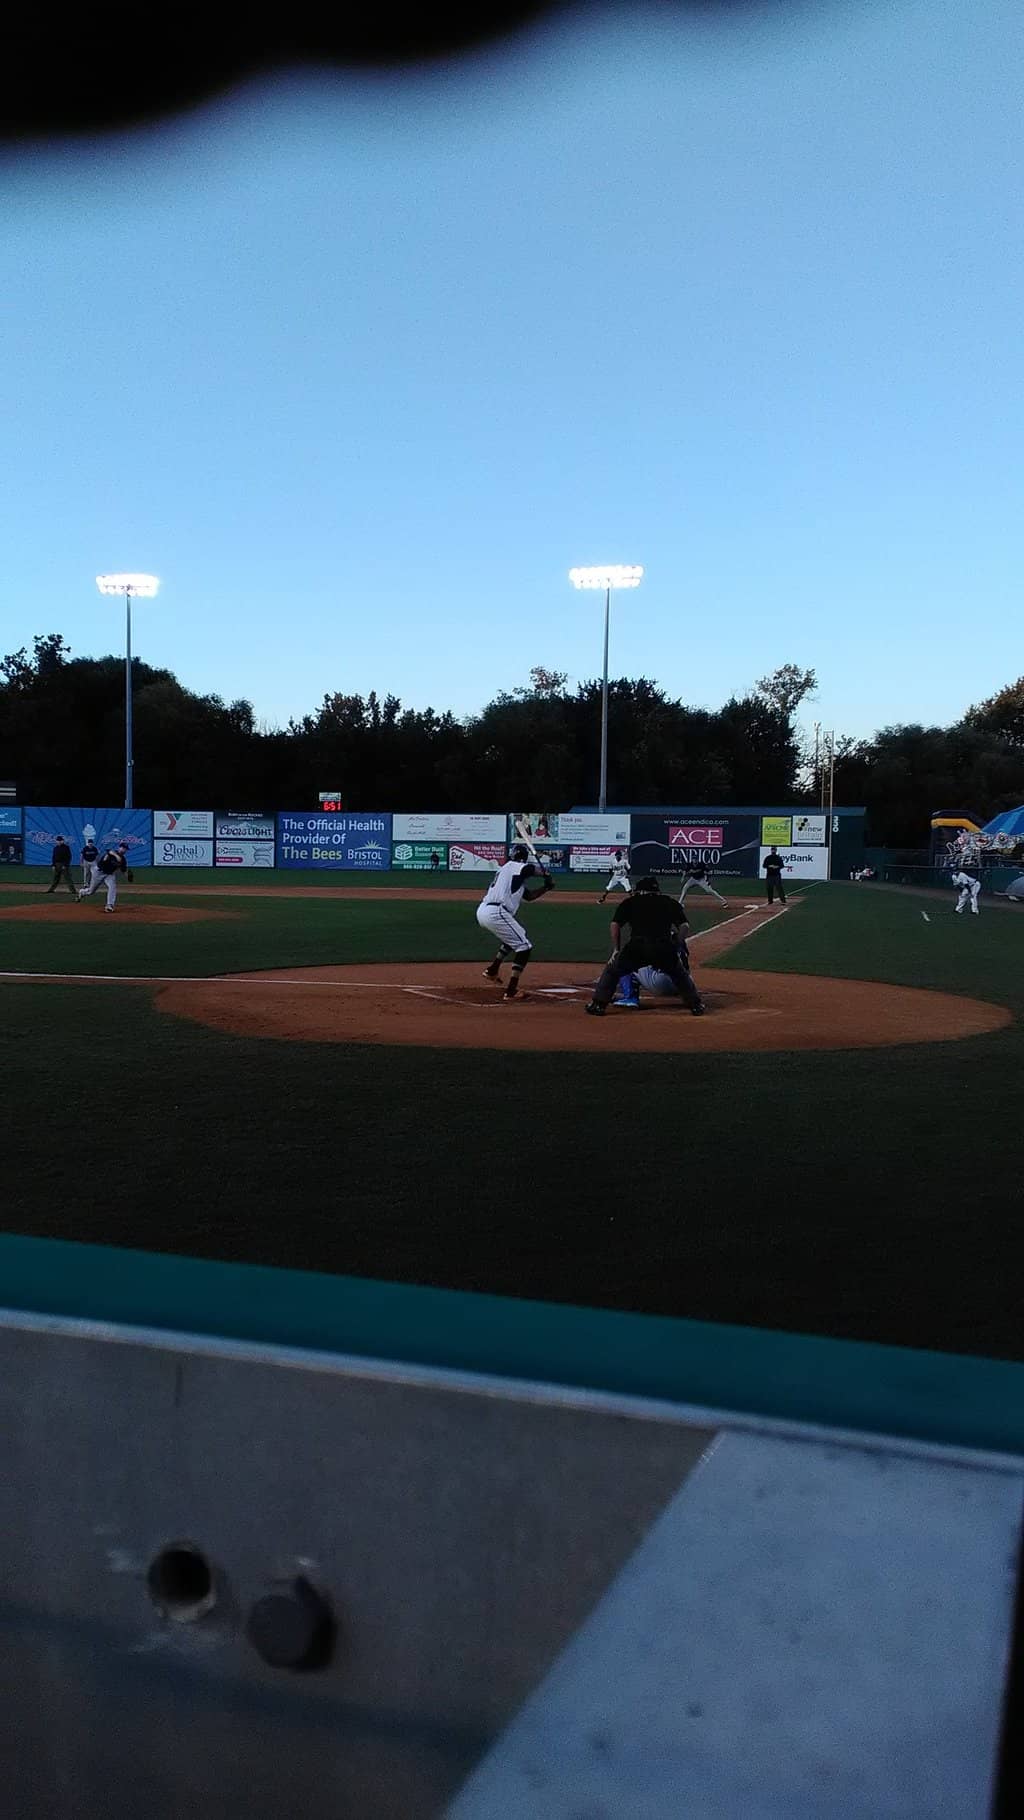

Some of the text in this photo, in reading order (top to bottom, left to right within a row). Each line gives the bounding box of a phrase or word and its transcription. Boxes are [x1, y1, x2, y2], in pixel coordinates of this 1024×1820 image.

[282, 818, 384, 831] The Official Health
[282, 833, 346, 844] Provider Of
[671, 829, 721, 844] ACE
[282, 846, 342, 860] The Bees
[780, 854, 813, 863] eyBank
